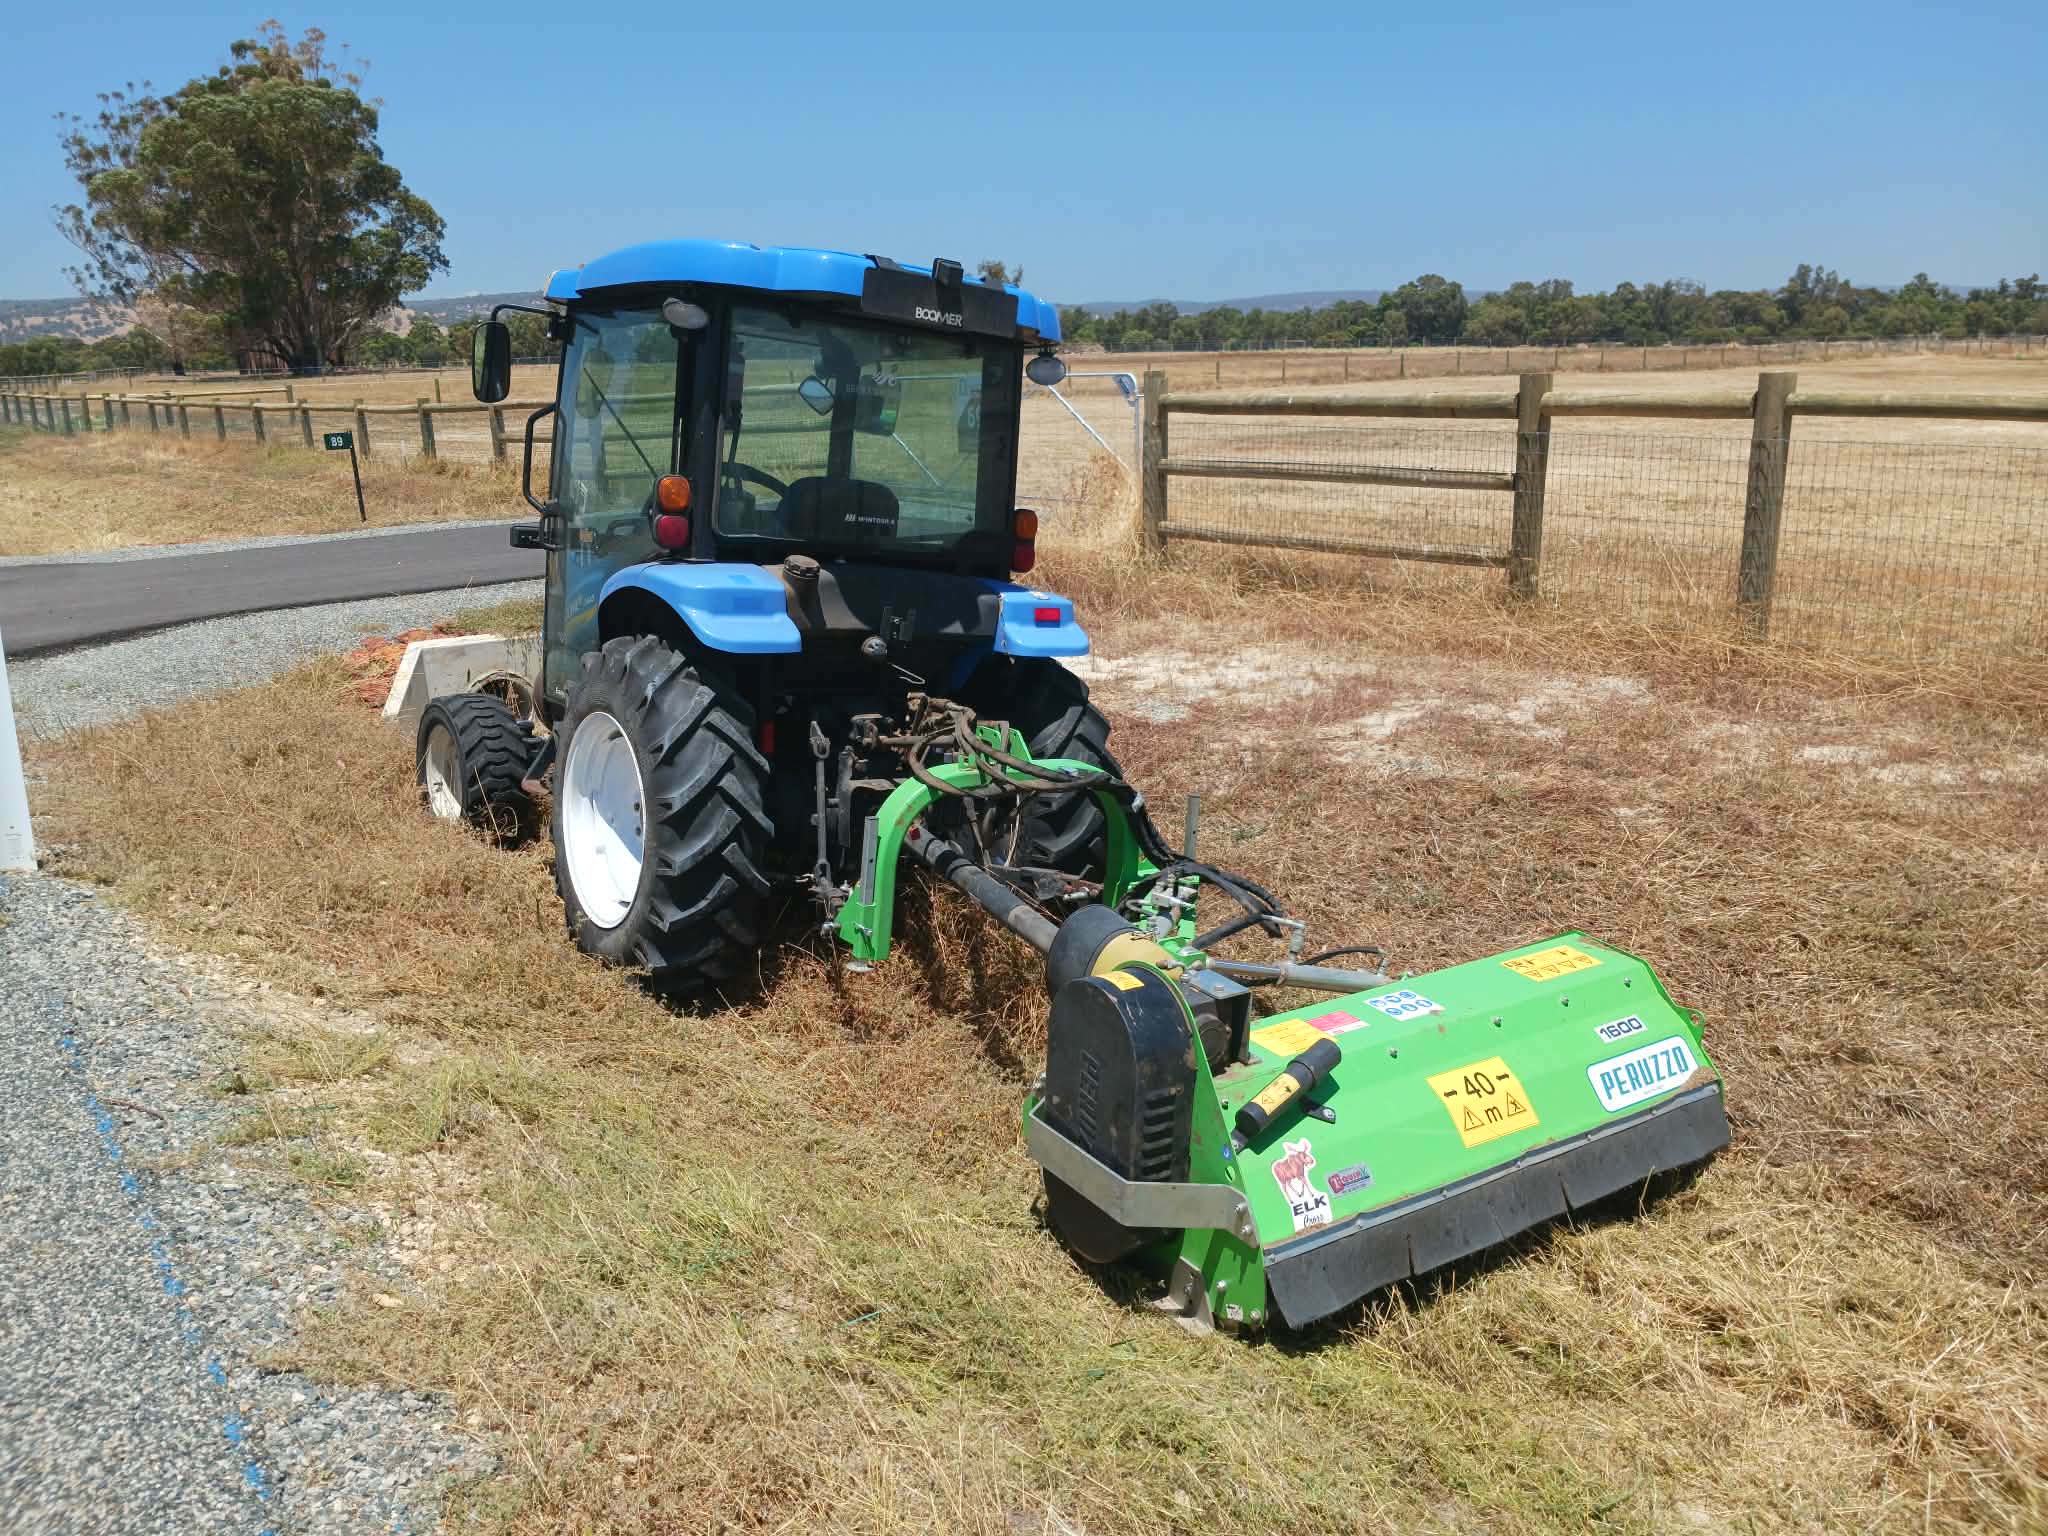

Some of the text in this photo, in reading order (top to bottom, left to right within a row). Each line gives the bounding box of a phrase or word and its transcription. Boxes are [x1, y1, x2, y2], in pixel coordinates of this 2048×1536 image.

[915, 306, 962, 327] BOOMER
[1600, 1017, 1643, 1039] 1600
[1600, 1046, 1689, 1101] PERUZZO
[1463, 1072, 1495, 1098] 40
[1484, 1106, 1503, 1123] m
[1293, 1195, 1327, 1216] ELK
